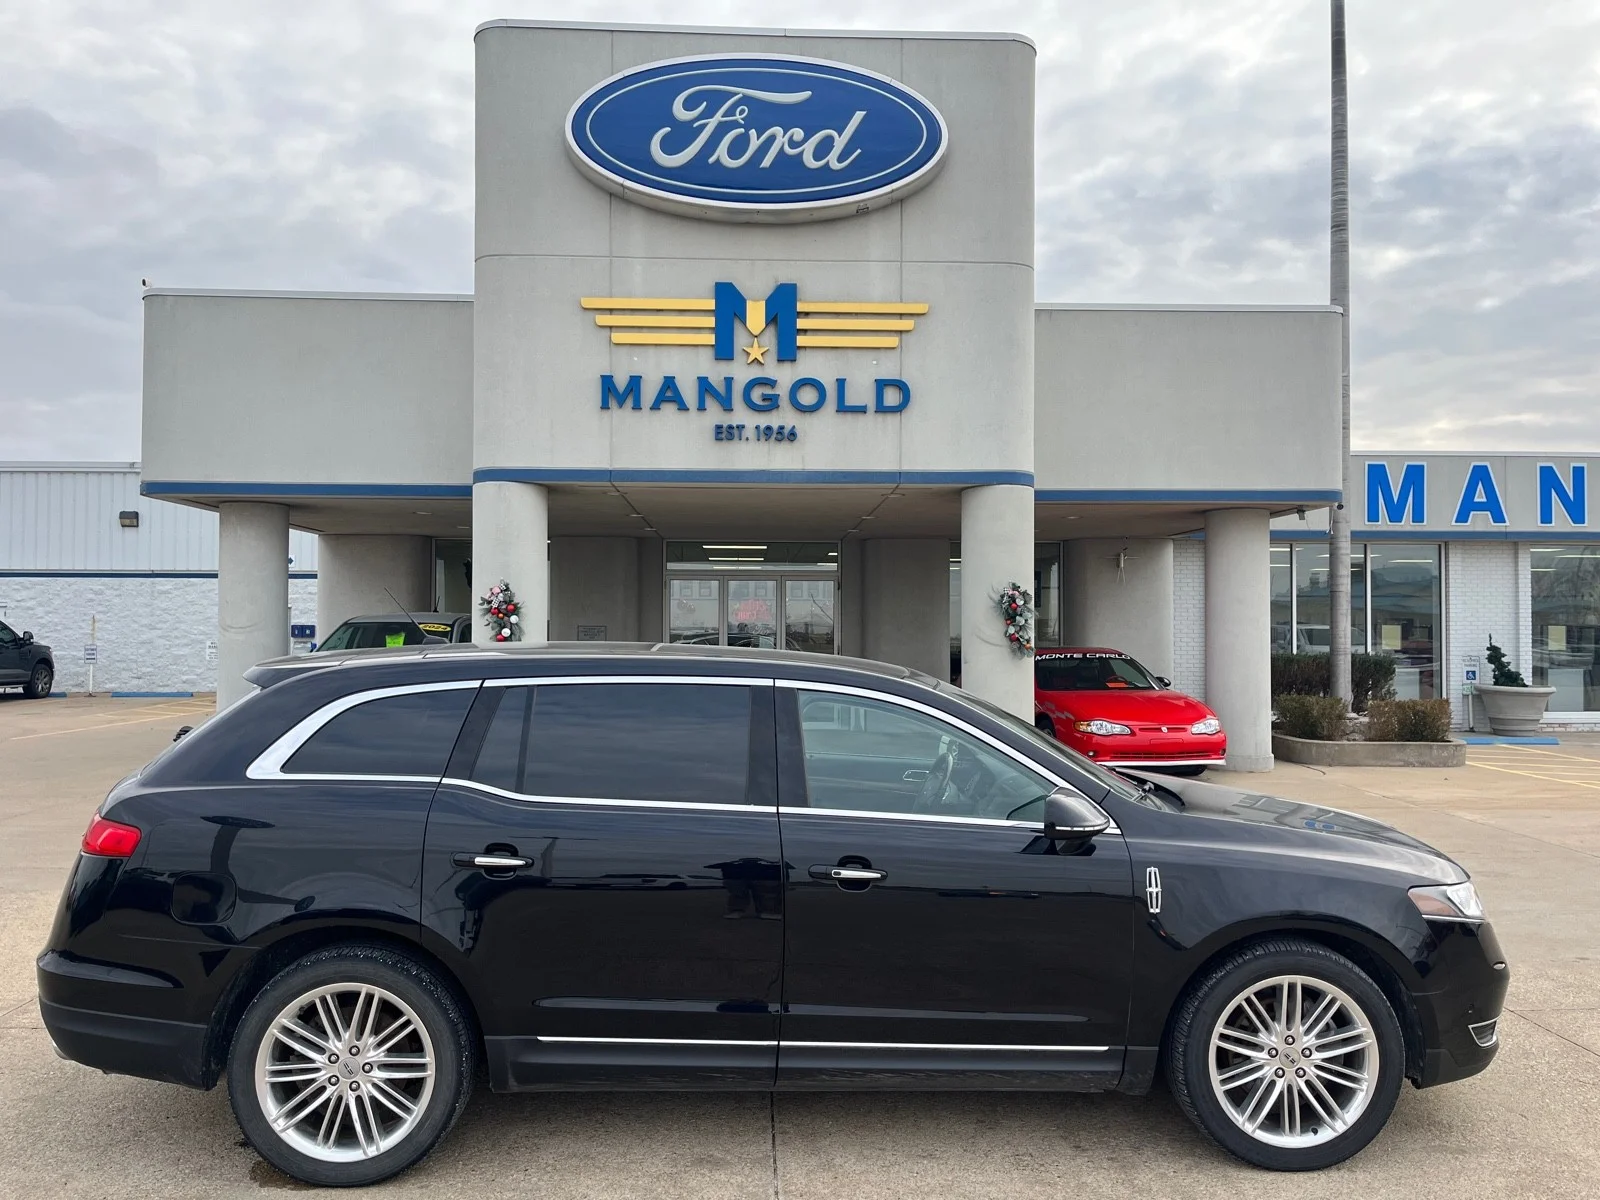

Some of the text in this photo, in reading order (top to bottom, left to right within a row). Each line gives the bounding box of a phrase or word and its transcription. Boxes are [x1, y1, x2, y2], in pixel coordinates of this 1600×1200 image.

[650, 84, 867, 170] Ford
[714, 281, 797, 361] M
[599, 374, 911, 414] MANGOLD
[714, 424, 798, 442] EST. 1956
[1035, 653, 1083, 661] MONTE
